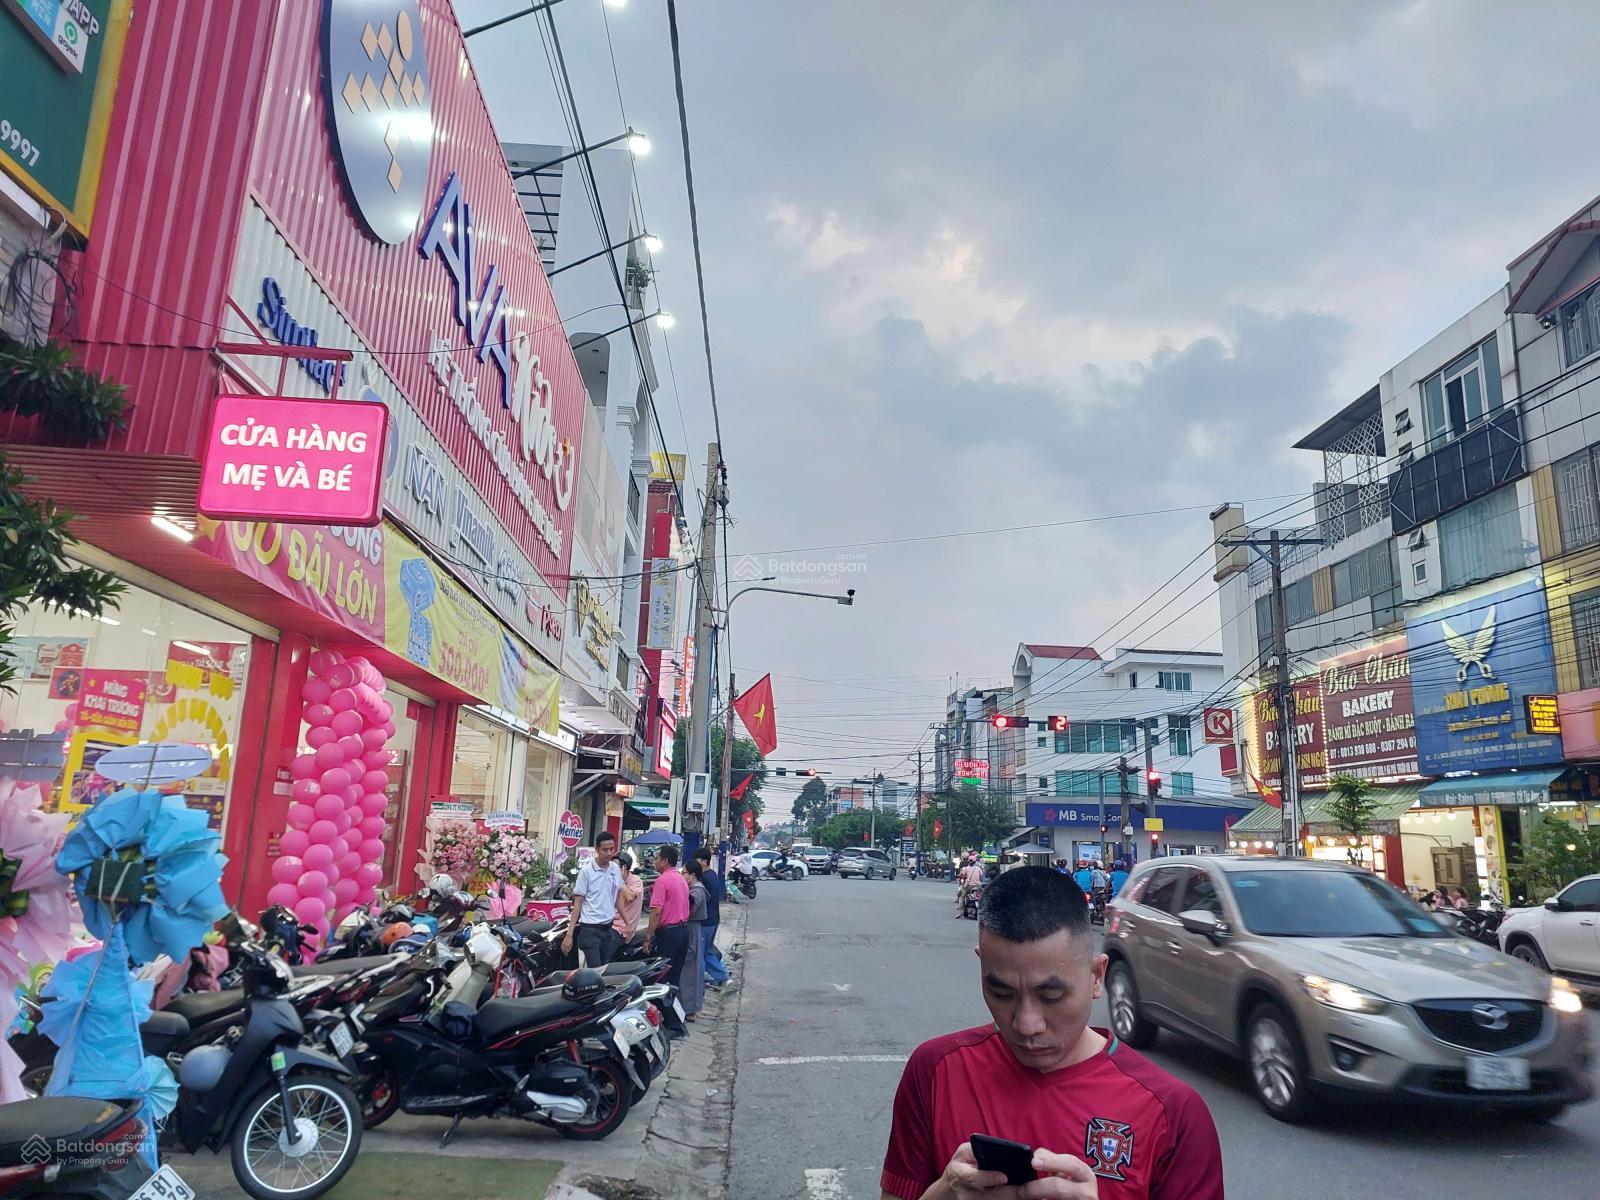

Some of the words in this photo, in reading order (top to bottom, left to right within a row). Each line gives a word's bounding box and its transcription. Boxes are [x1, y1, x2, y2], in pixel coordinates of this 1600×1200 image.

[57, 34, 79, 58] gojek
[220, 417, 279, 447] CỬA
[285, 424, 367, 453] HÀNG
[222, 462, 268, 491] MẸ
[273, 460, 310, 489] VÀ
[317, 463, 353, 491] BÉ
[406, 443, 448, 523] NAN
[287, 529, 332, 597] ĐÃI
[335, 559, 378, 625] LỚN
[1342, 690, 1394, 717] BAKERY
[558, 822, 583, 838] Merries
[1058, 810, 1078, 821] MB
